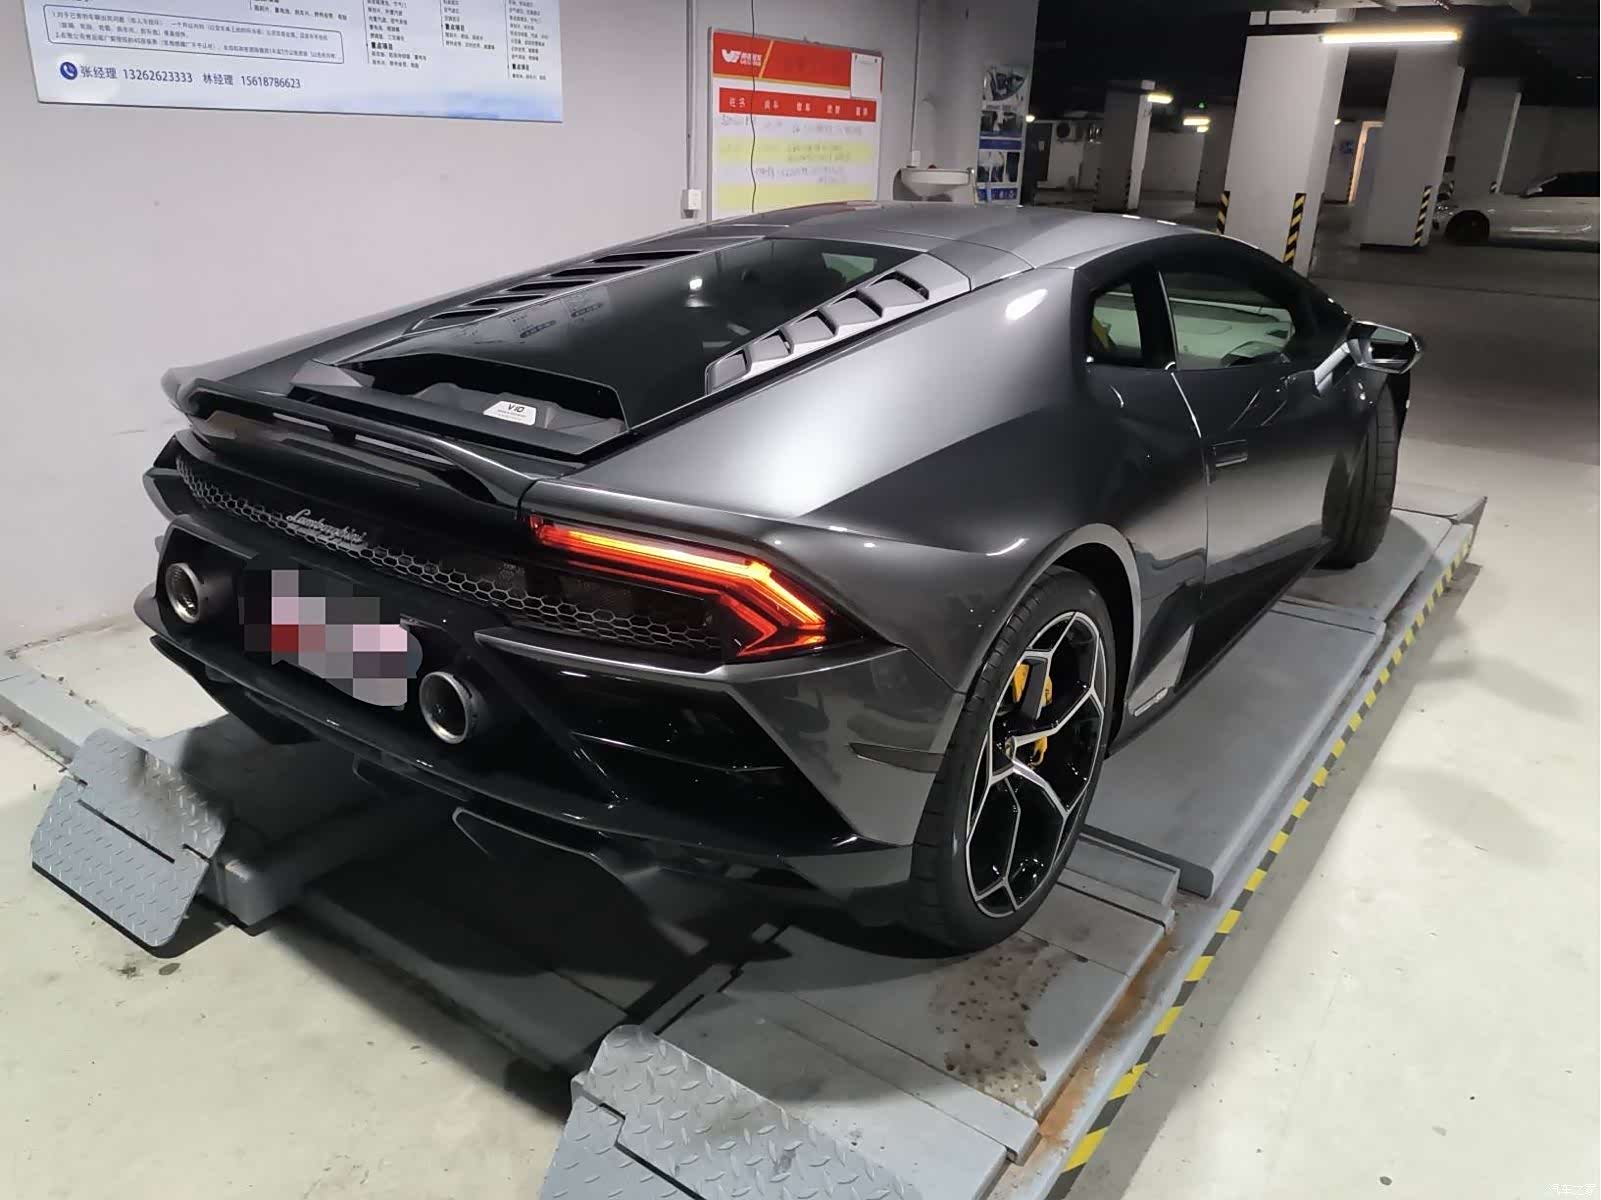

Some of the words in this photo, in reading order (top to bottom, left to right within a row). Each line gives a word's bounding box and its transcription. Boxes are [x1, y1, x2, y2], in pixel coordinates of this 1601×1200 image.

[80, 65, 117, 80] 张经理
[123, 69, 193, 83] 13262623333
[203, 72, 234, 86] 林经理
[241, 74, 301, 89] 15618786623
